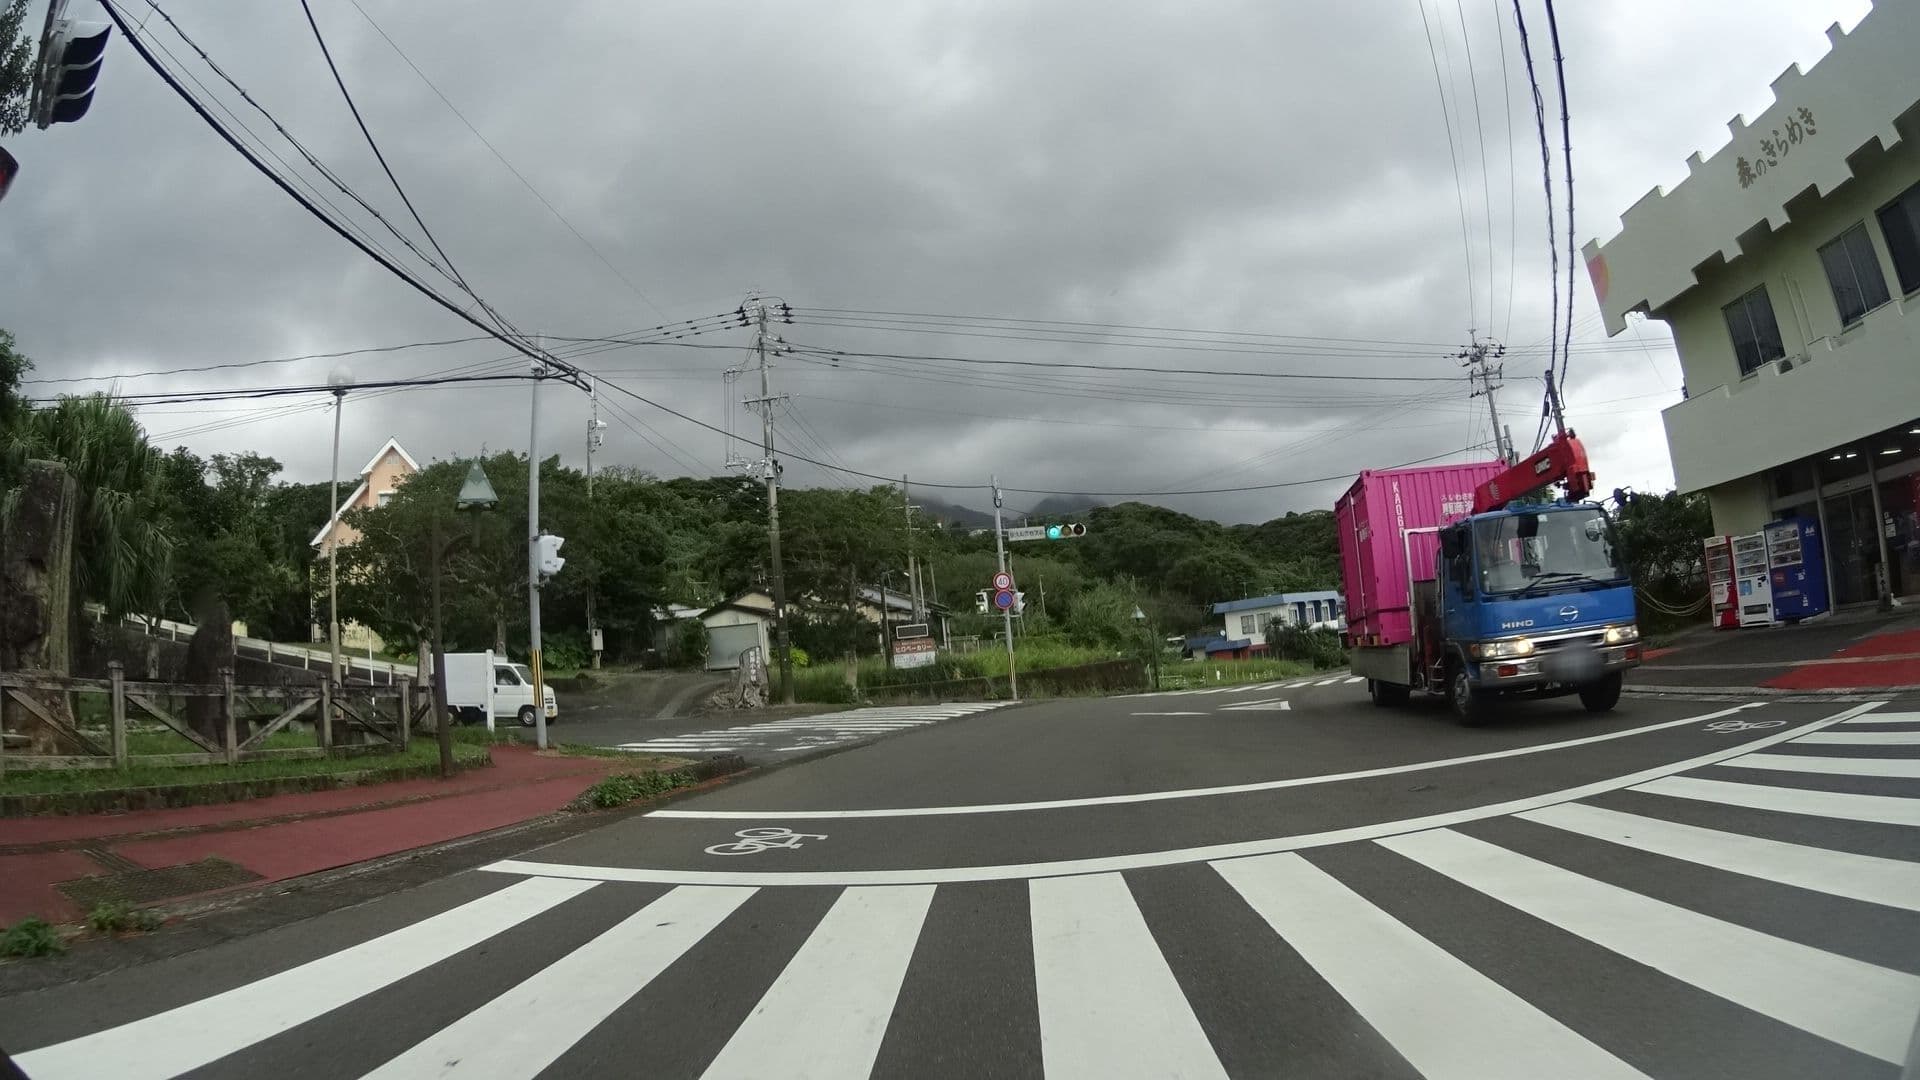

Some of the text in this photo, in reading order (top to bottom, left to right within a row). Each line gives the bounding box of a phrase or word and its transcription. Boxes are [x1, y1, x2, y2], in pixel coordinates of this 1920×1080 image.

[1737, 107, 1816, 189] 森のきらめき
[998, 577, 1008, 586] 40
[1501, 619, 1534, 629] HINO
